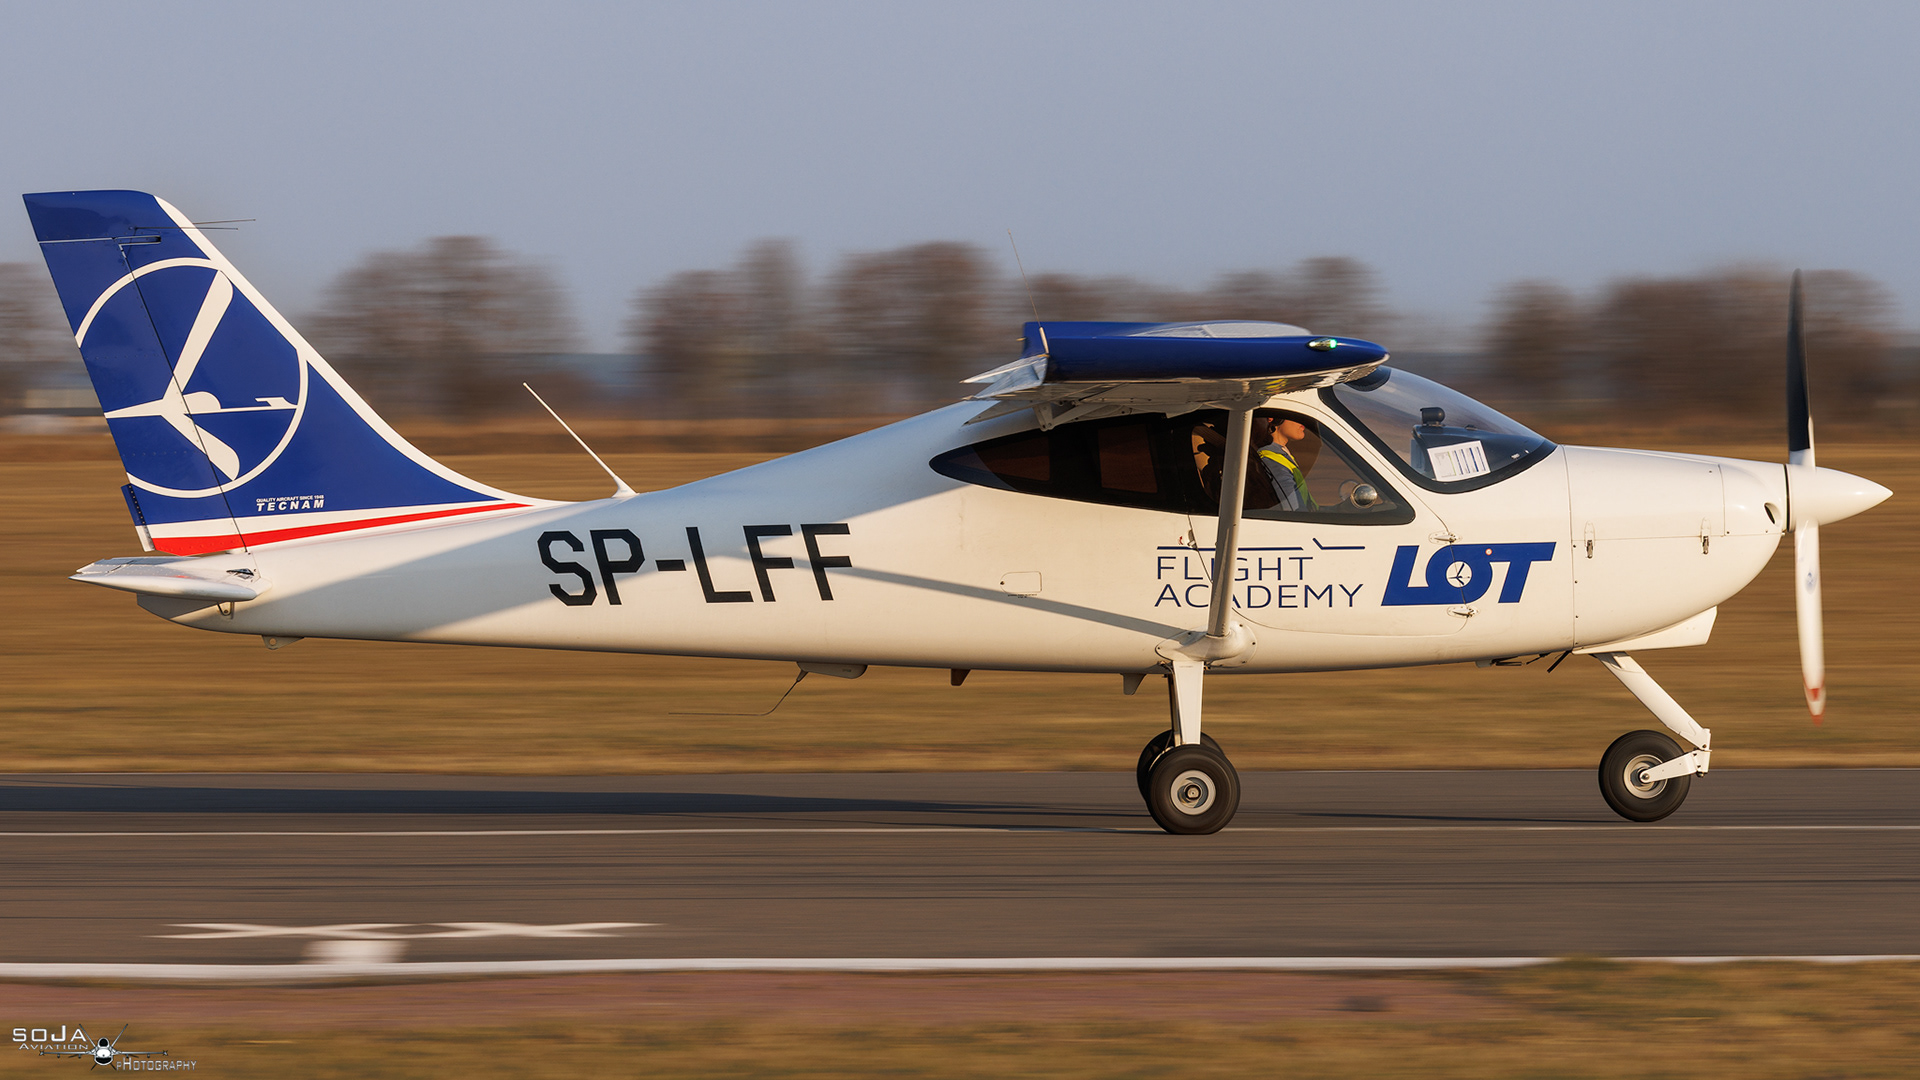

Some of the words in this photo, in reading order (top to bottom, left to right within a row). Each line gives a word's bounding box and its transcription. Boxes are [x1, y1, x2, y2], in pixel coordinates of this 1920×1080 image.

[257, 500, 324, 512] TECNAM
[537, 523, 853, 607] SP-LFF
[1380, 541, 1557, 606] LOT
